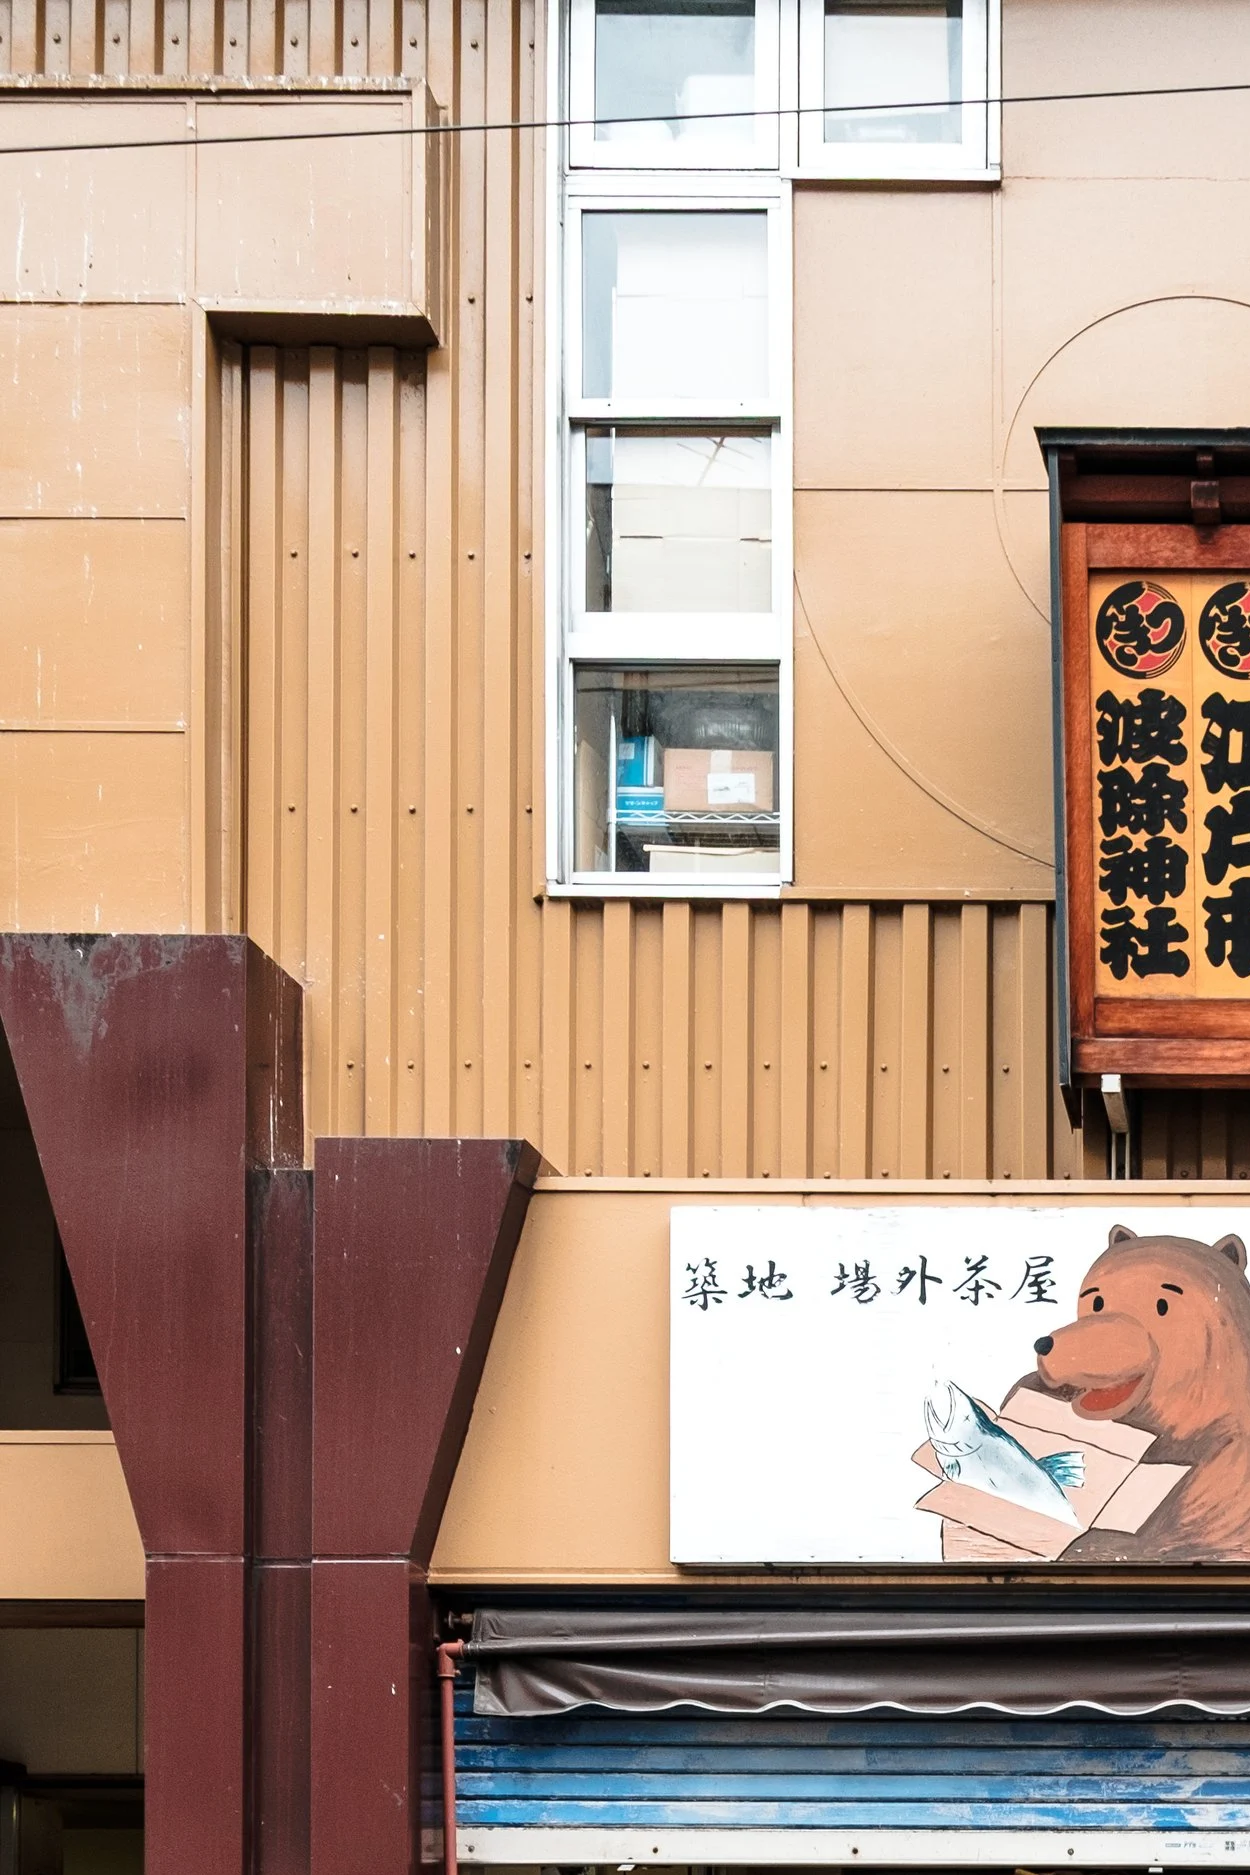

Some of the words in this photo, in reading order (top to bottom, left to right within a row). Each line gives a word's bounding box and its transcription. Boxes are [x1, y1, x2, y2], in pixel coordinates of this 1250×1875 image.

[1096, 688, 1190, 980] 波除神社
[681, 1257, 794, 1311] 築地
[830, 1255, 1059, 1306] 場外茶屋
